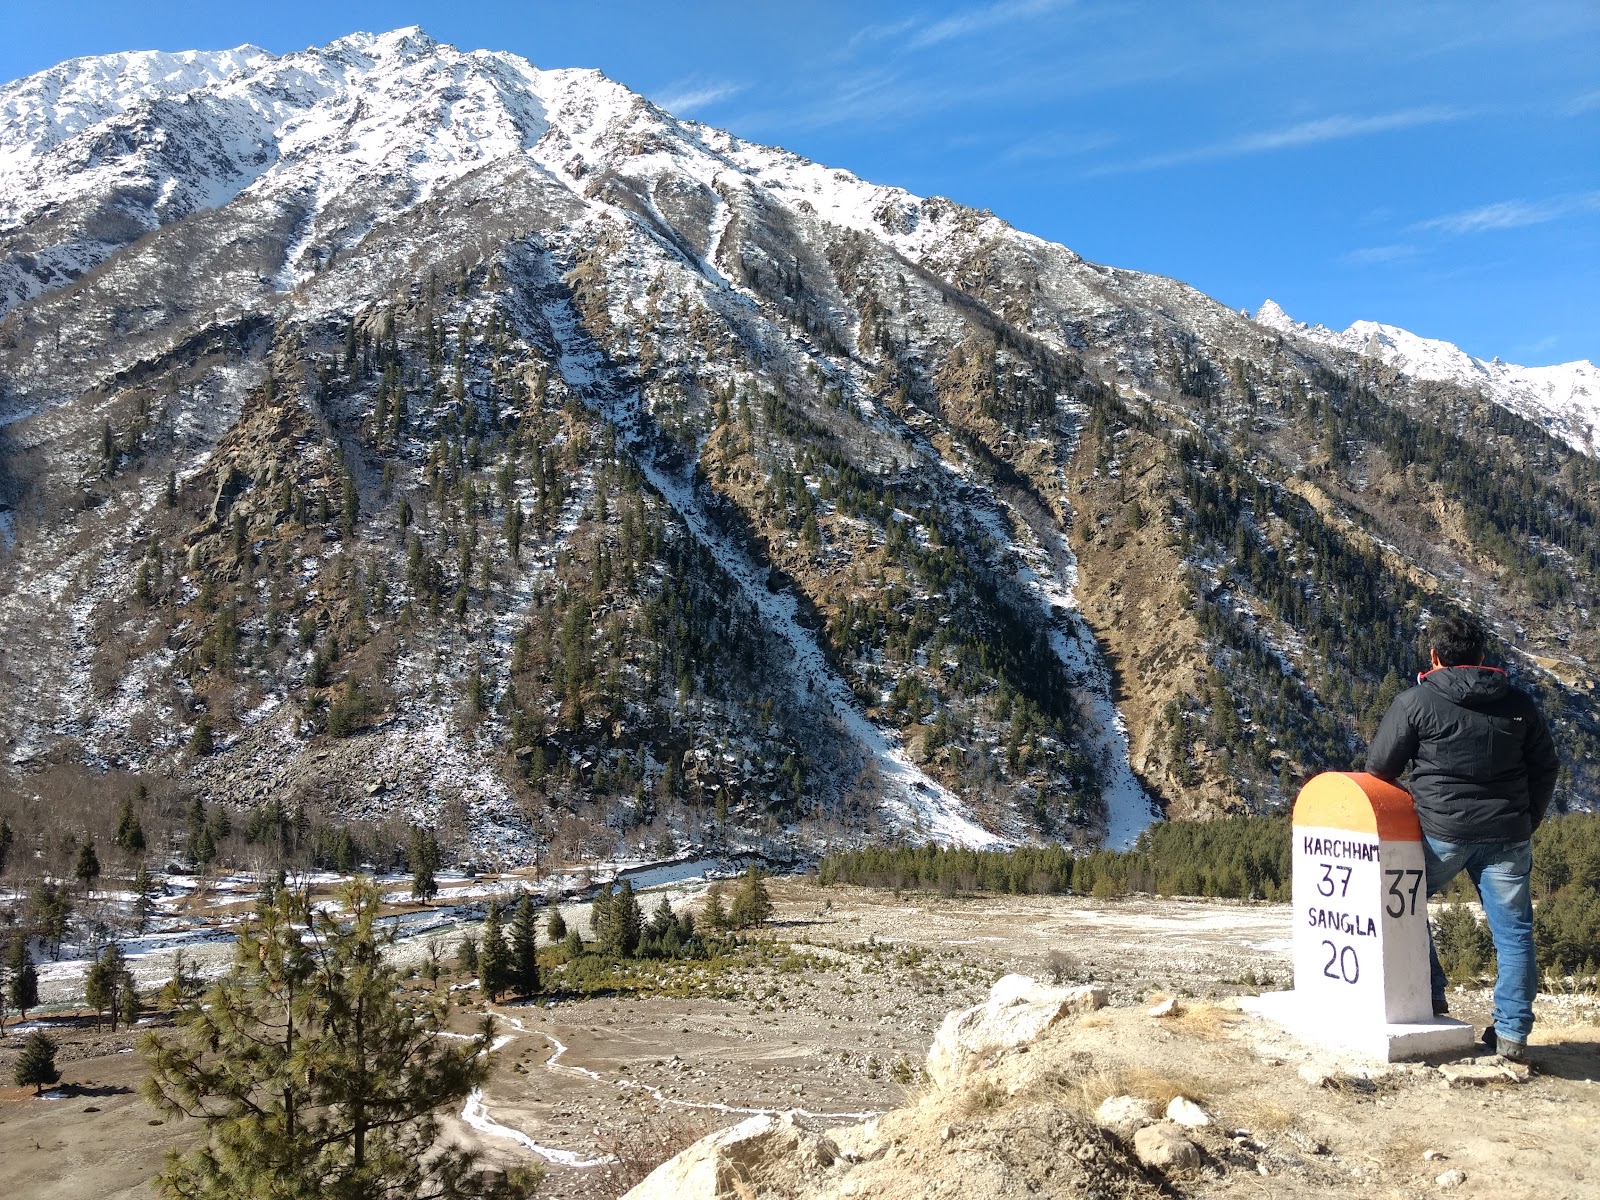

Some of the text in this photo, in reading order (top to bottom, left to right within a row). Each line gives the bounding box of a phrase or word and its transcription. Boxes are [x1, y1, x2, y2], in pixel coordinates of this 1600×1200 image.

[1304, 836, 1380, 862] KARCHHAM
[1317, 863, 1352, 897] 37
[1385, 869, 1423, 919] 37
[1308, 907, 1377, 937] SANGLA
[1321, 940, 1359, 984] 20
